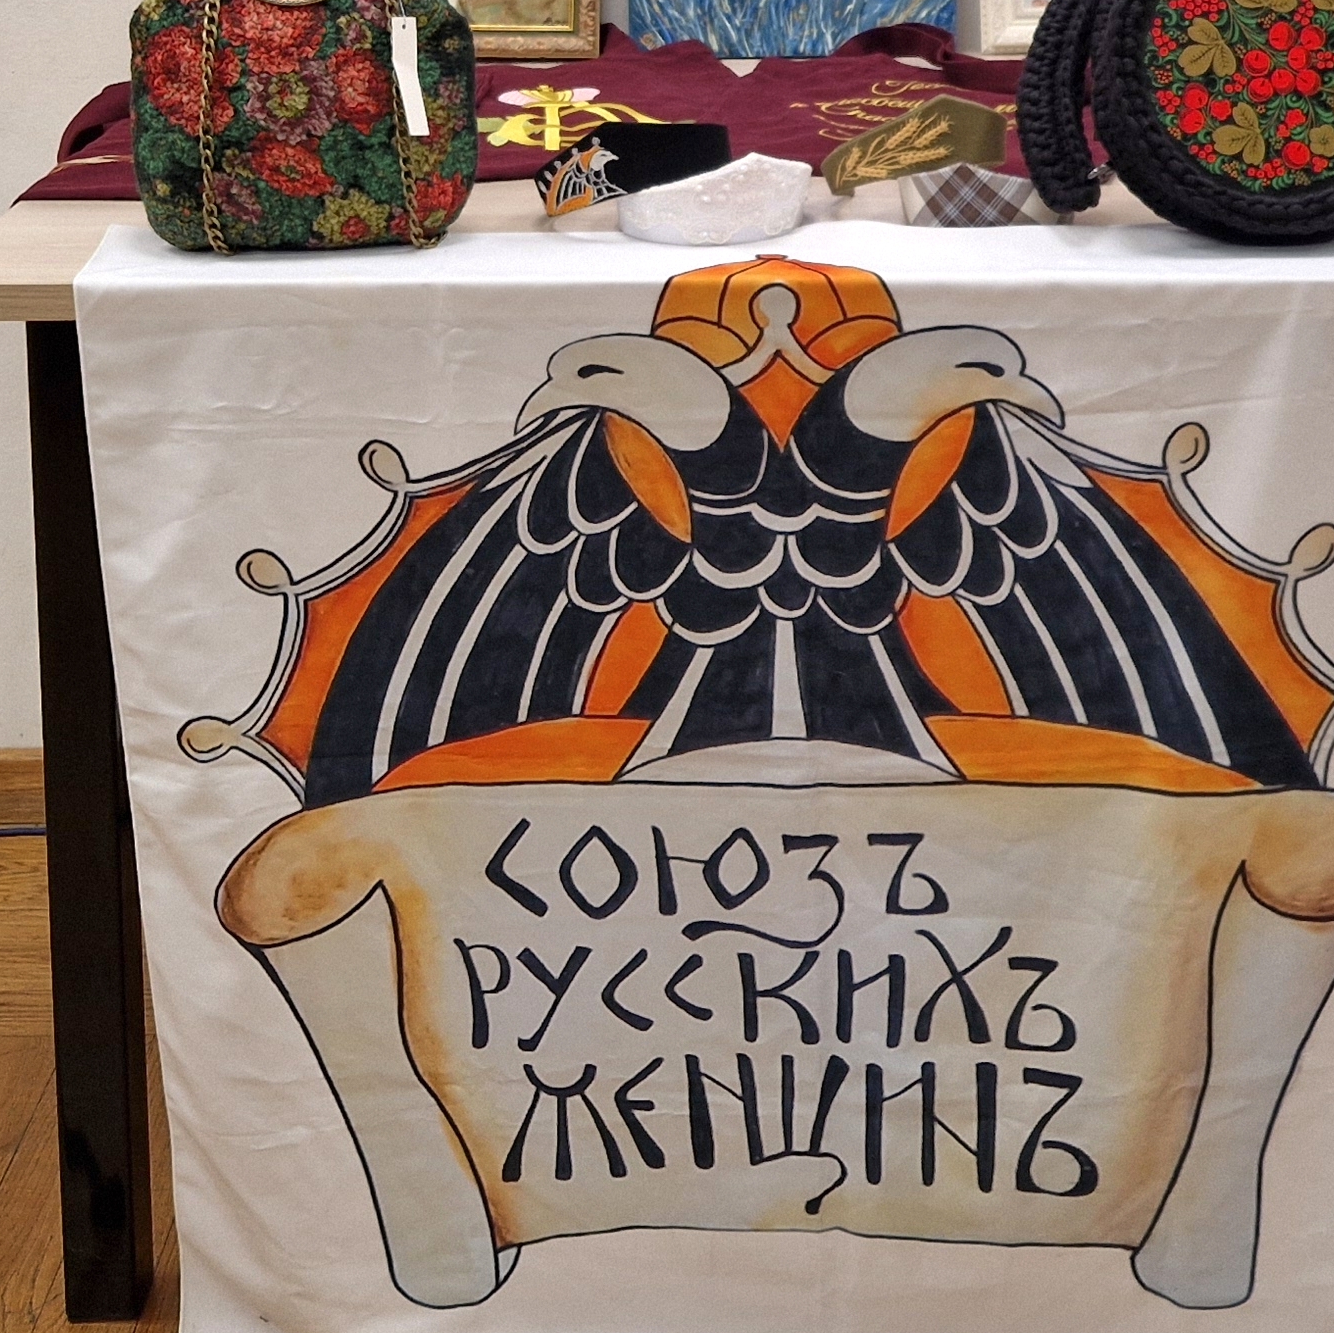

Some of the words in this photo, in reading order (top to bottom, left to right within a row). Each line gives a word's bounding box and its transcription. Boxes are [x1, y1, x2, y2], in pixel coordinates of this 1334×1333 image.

[485, 818, 950, 949] СОЮЗЪ
[453, 925, 1078, 1053] РУССКИХЪ
[502, 1053, 1099, 1215] ЖЕНЩИНЪ
